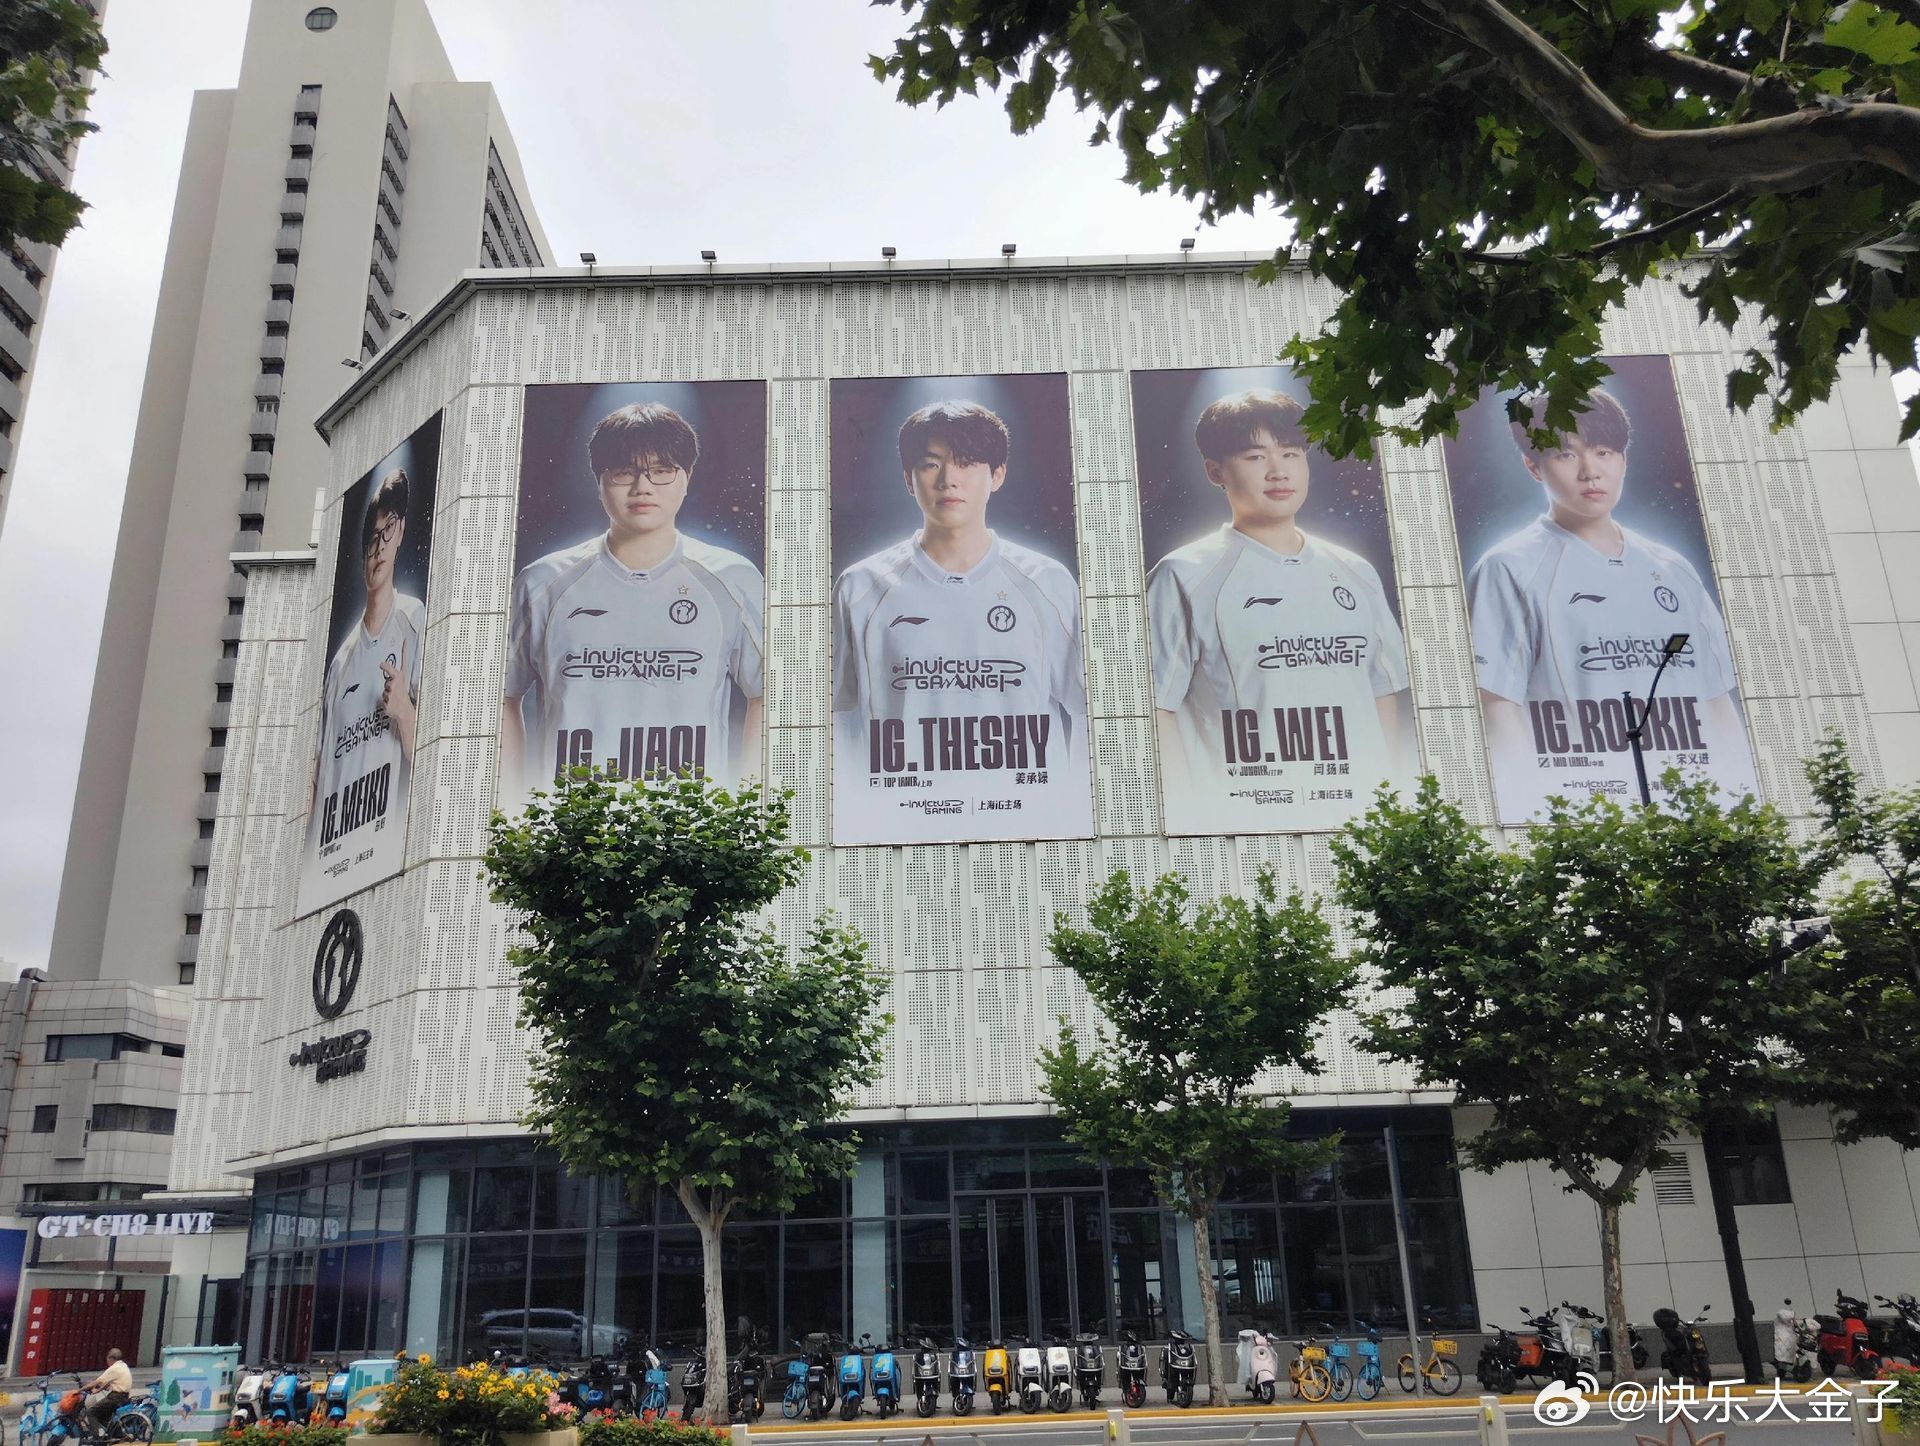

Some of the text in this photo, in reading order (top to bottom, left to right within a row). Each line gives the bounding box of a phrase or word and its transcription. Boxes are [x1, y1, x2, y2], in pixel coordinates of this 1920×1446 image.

[555, 725, 707, 783] IG.JIAQI
[870, 714, 1050, 773] IG.THESHY
[1221, 706, 1348, 764] IG.WEI
[1529, 696, 1707, 754] IG.ROOKIE
[320, 763, 391, 848] IG.MEIKO
[884, 777, 896, 787] TOP
[924, 807, 962, 815] GAMING
[1255, 796, 1294, 805] GAMING
[154, 1212, 215, 1235] LIVE
